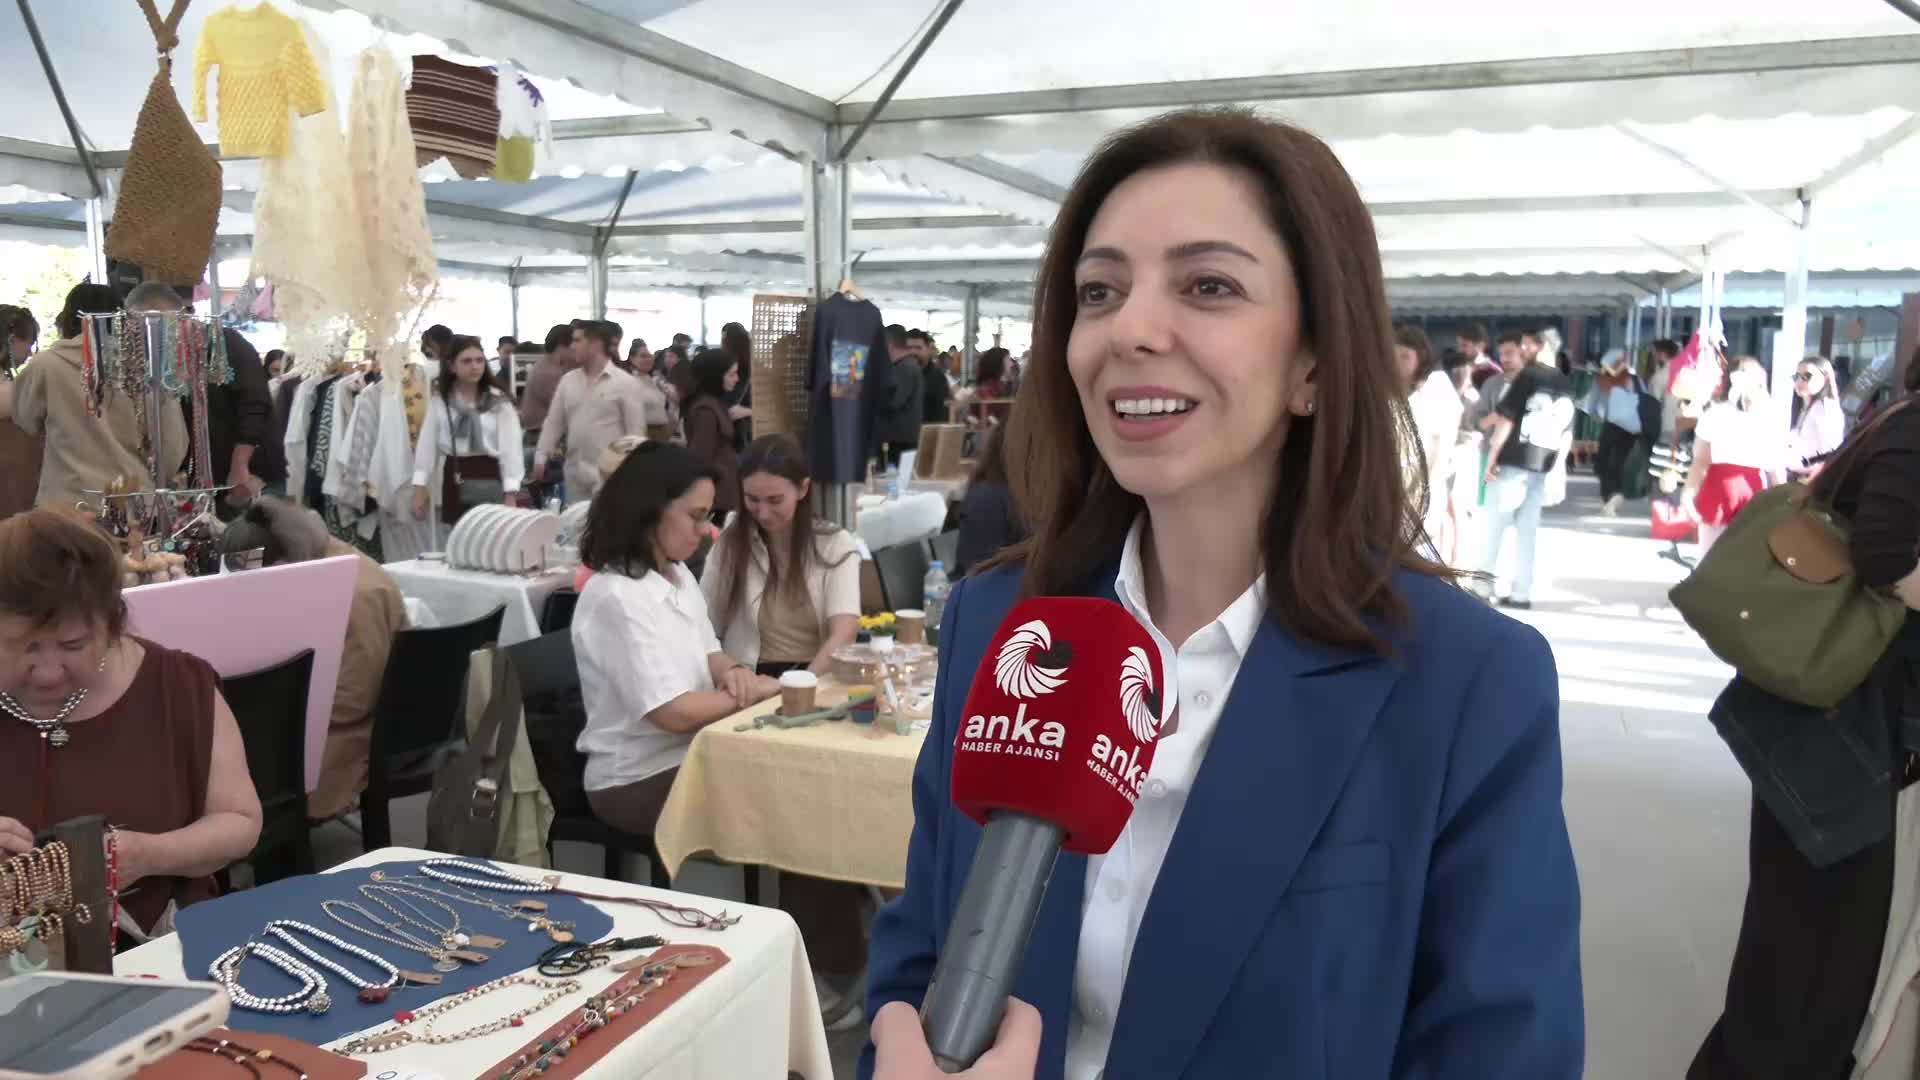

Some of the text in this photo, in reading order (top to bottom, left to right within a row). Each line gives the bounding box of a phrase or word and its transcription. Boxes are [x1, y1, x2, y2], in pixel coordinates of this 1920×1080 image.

[964, 703, 1066, 748] anka
[961, 741, 1060, 761] HABER AJANSI
[1086, 759, 1136, 803] HABER AJAN
